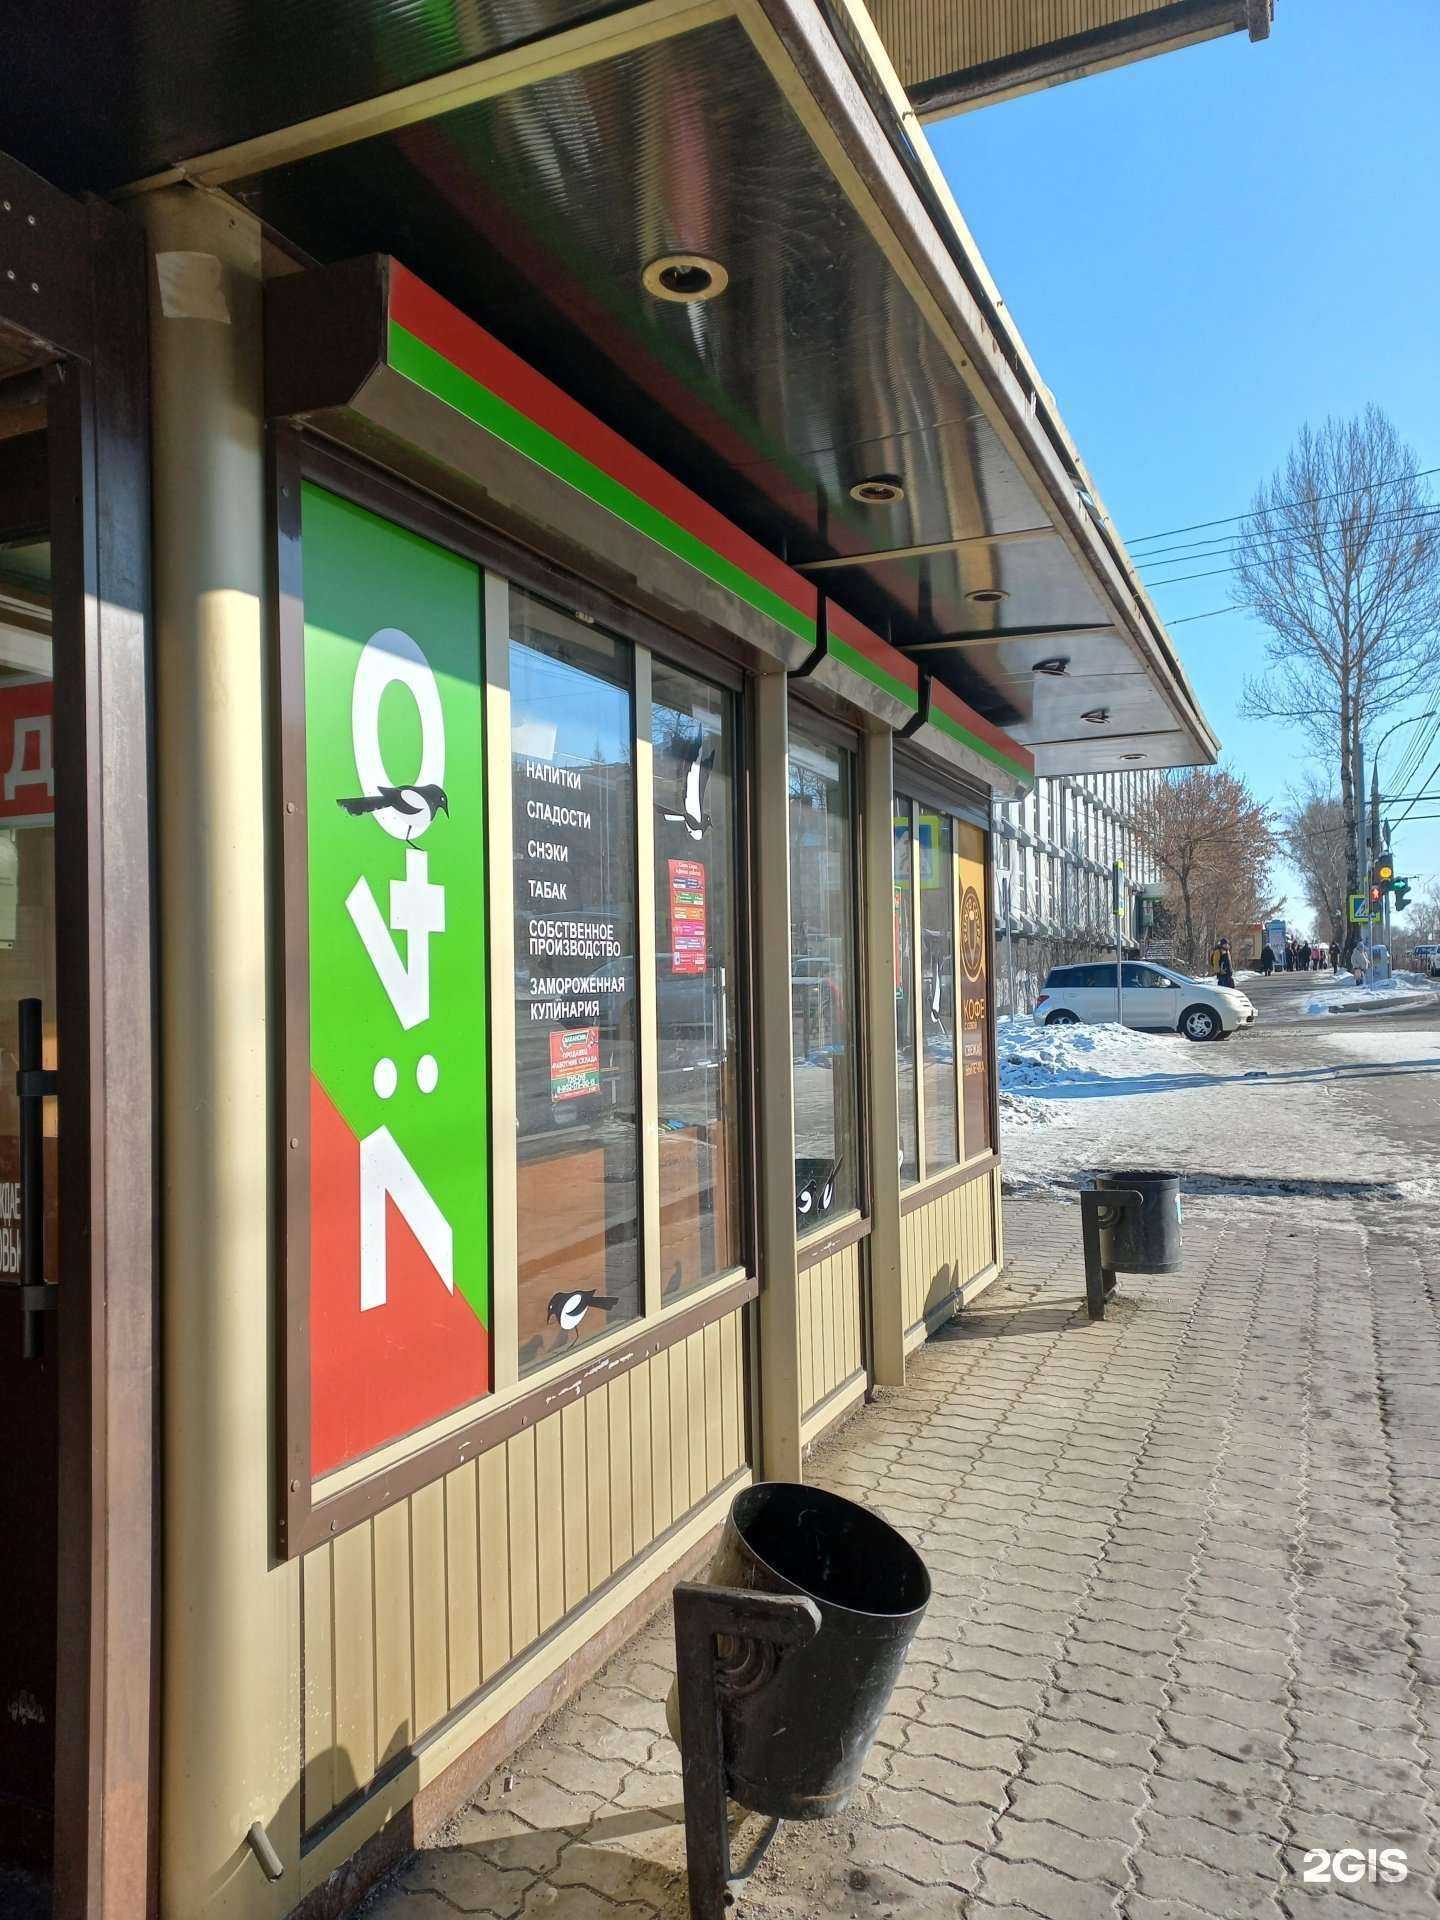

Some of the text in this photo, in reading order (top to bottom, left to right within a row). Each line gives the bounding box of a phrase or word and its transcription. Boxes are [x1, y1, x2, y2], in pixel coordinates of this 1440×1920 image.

[526, 760, 582, 791] НАПИТКИ
[527, 800, 591, 830] СЛАДОСТИ
[528, 840, 568, 863] СНЭКИ
[528, 880, 567, 900] ТАБАК
[529, 919, 614, 940] СОБСТВЕННОЕ
[529, 938, 621, 960] ПРОИЗВОДСТВО
[530, 976, 625, 995] ЗАМОРОЖЕННАЯ
[530, 1000, 600, 1021] КУЛИНАРИЯ
[964, 998, 985, 1022] КОФЕ
